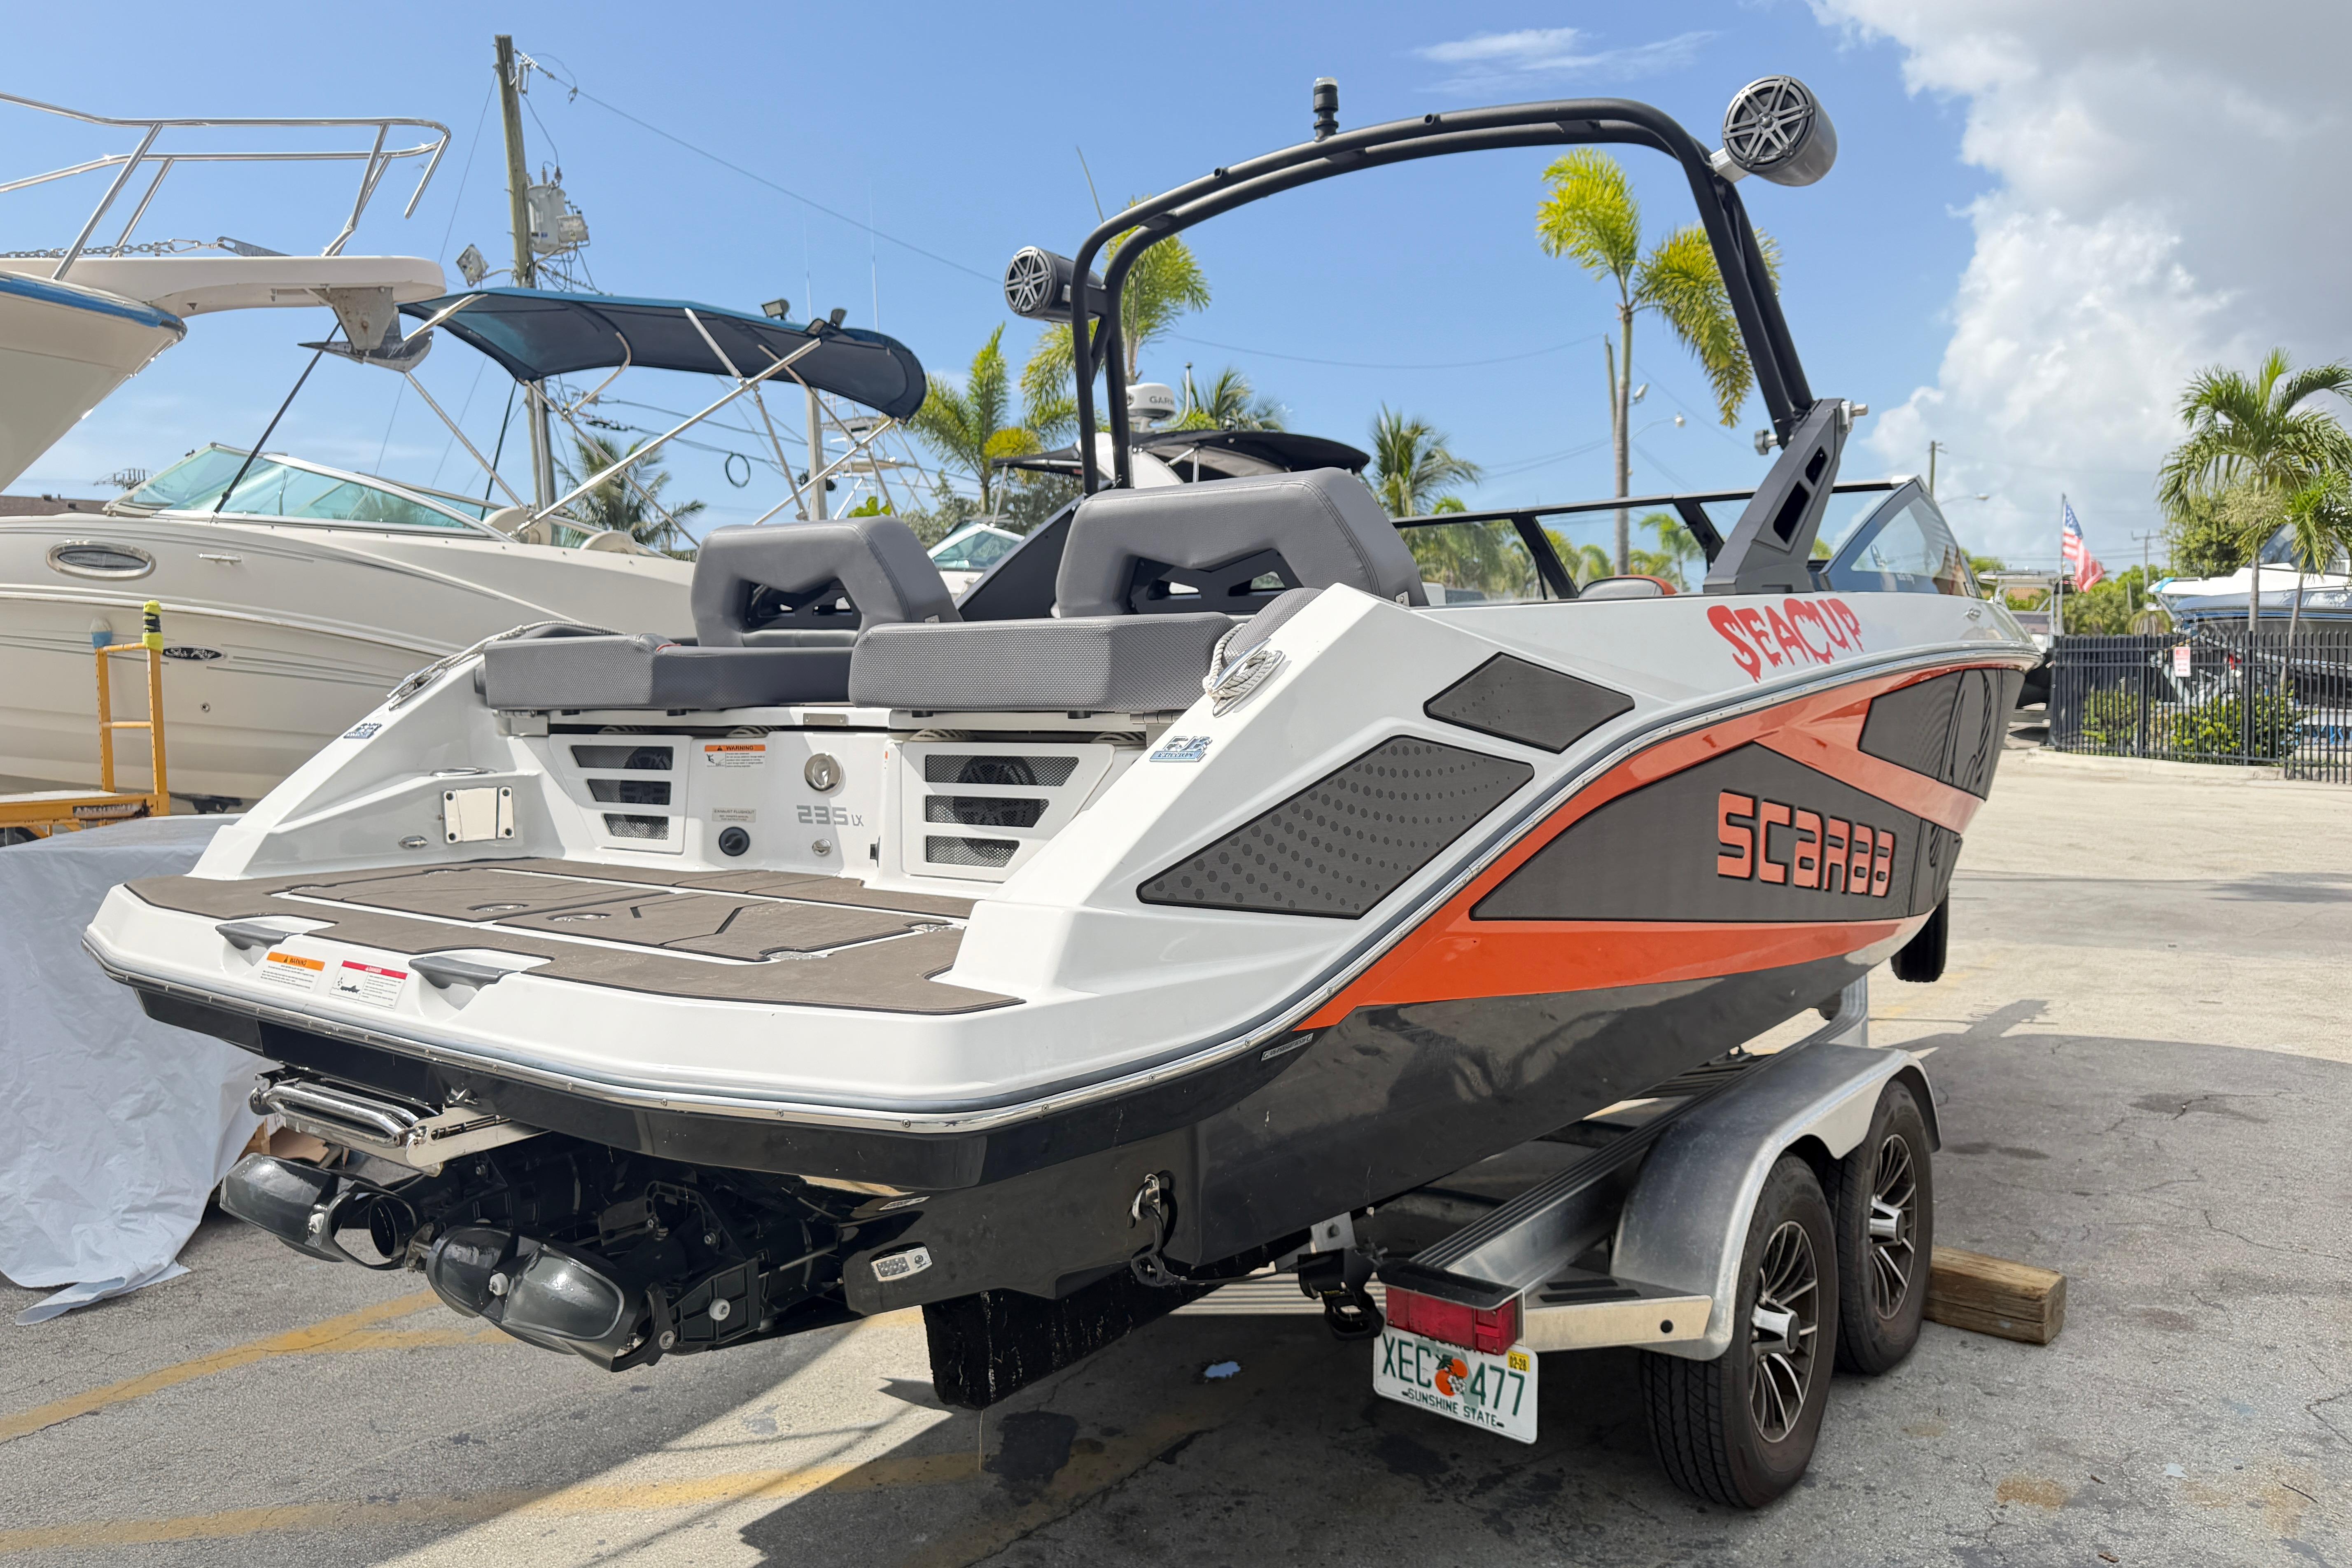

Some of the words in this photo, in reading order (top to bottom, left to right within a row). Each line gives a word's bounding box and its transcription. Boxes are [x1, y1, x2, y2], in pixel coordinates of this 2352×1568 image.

[1707, 598, 1864, 683] SEACUP
[797, 805, 849, 825] 235
[851, 814, 864, 826] LX
[289, 957, 307, 966] WARNING
[1383, 1332, 1431, 1388] XEC
[1470, 1361, 1525, 1416] 477
[1407, 1388, 1458, 1414] SUNSHINE
[1463, 1405, 1497, 1427] STATE
